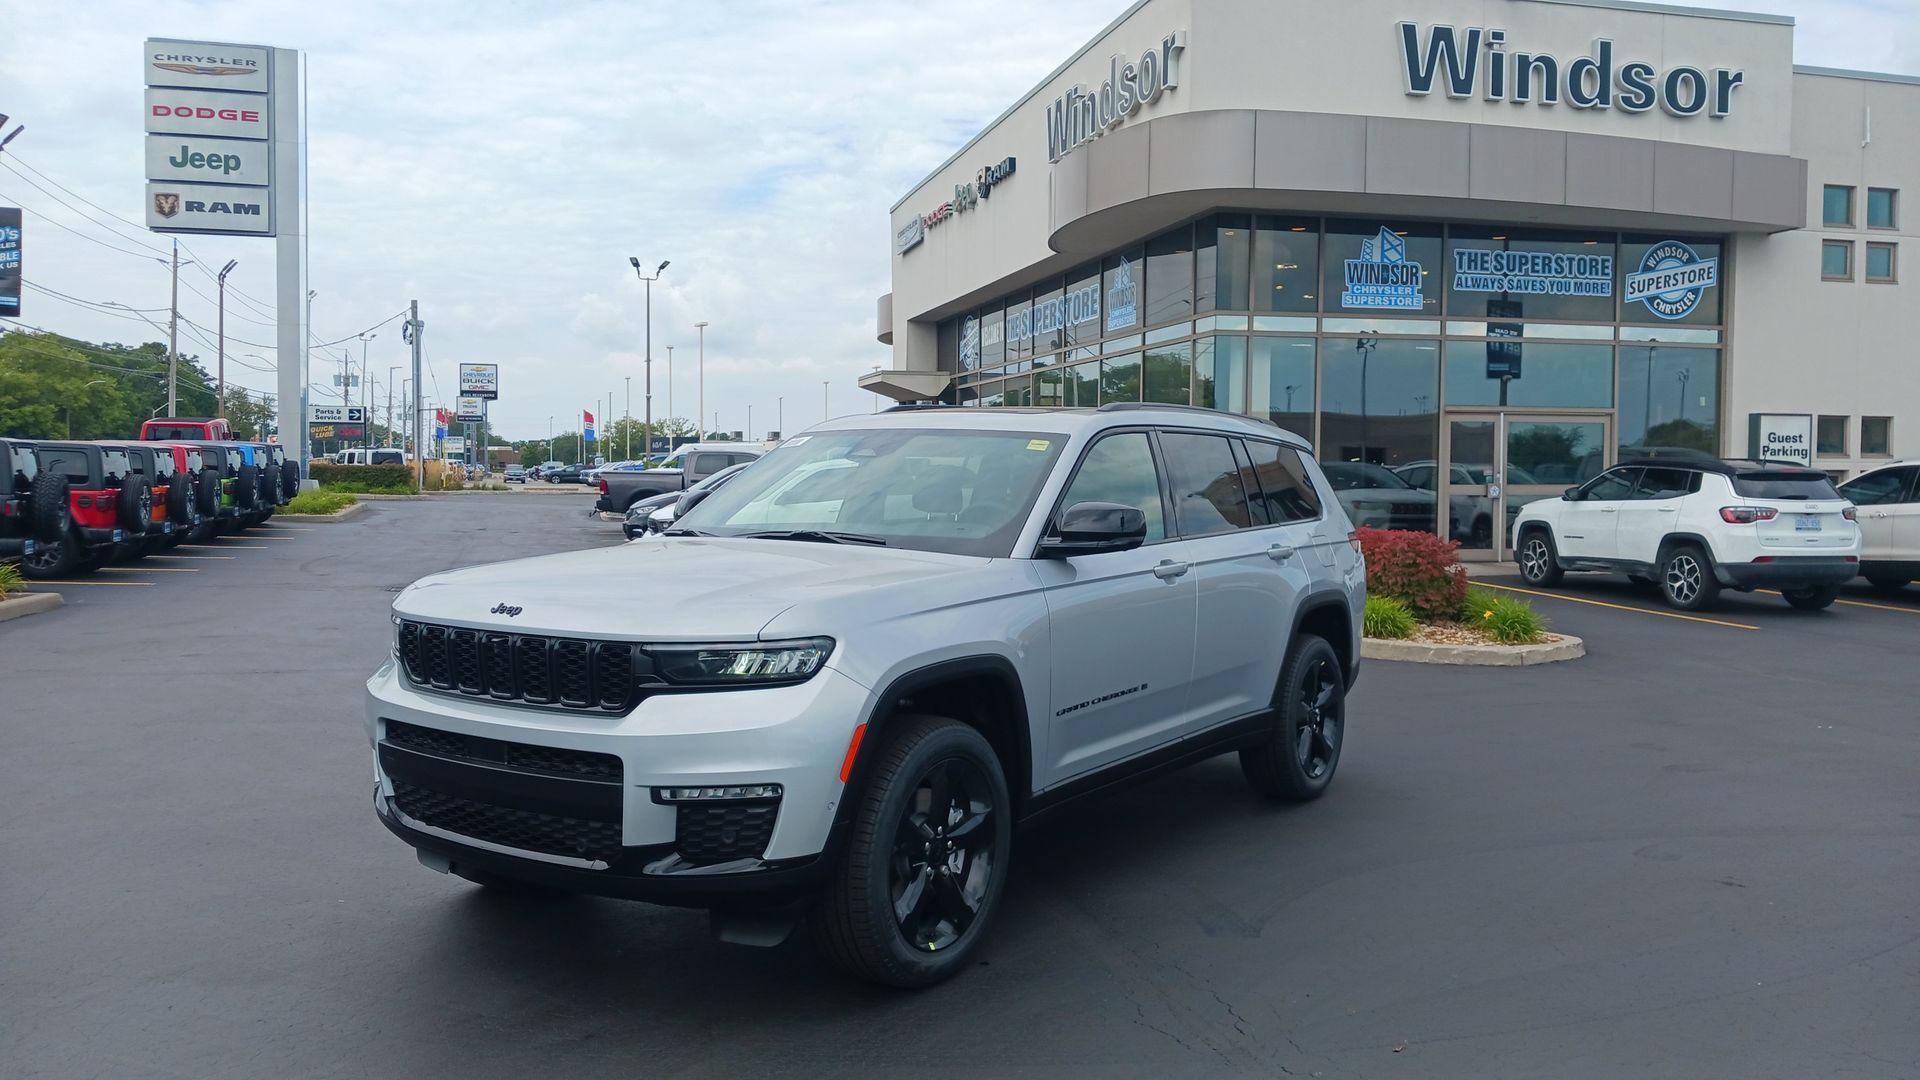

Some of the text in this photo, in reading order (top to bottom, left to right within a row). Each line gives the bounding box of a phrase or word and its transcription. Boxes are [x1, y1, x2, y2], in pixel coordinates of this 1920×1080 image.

[153, 53, 257, 67] CHRYSLER
[1396, 21, 1745, 118] Windsor
[1046, 30, 1186, 164] Windsor
[152, 105, 260, 123] DODGE
[169, 145, 242, 175] Jeep
[986, 156, 1016, 186] RAM
[185, 200, 261, 216] RAM
[921, 202, 953, 230] DODGE
[1455, 250, 1611, 277] THE SUPERSTORE
[1646, 246, 1690, 268] WINDSOR
[1346, 262, 1419, 286] WINDSOR
[1456, 275, 1611, 295] ALWAYS SAVES YOU MORE!
[1629, 266, 1713, 295] SUPERSTORE
[1345, 295, 1420, 306] SUPERSTORE
[1353, 285, 1413, 295] CHRYSLER
[1007, 314, 1020, 341] THE
[1021, 285, 1099, 340] SUPERSTORE
[1653, 291, 1696, 314] CHRYSLER
[310, 425, 335, 433] QUICK
[1767, 432, 1803, 443] Guest
[1762, 445, 1808, 459] Parking
[490, 602, 523, 618] Jeep
[1056, 701, 1090, 717] GRAND
[1091, 686, 1139, 705] CHEROKEE
